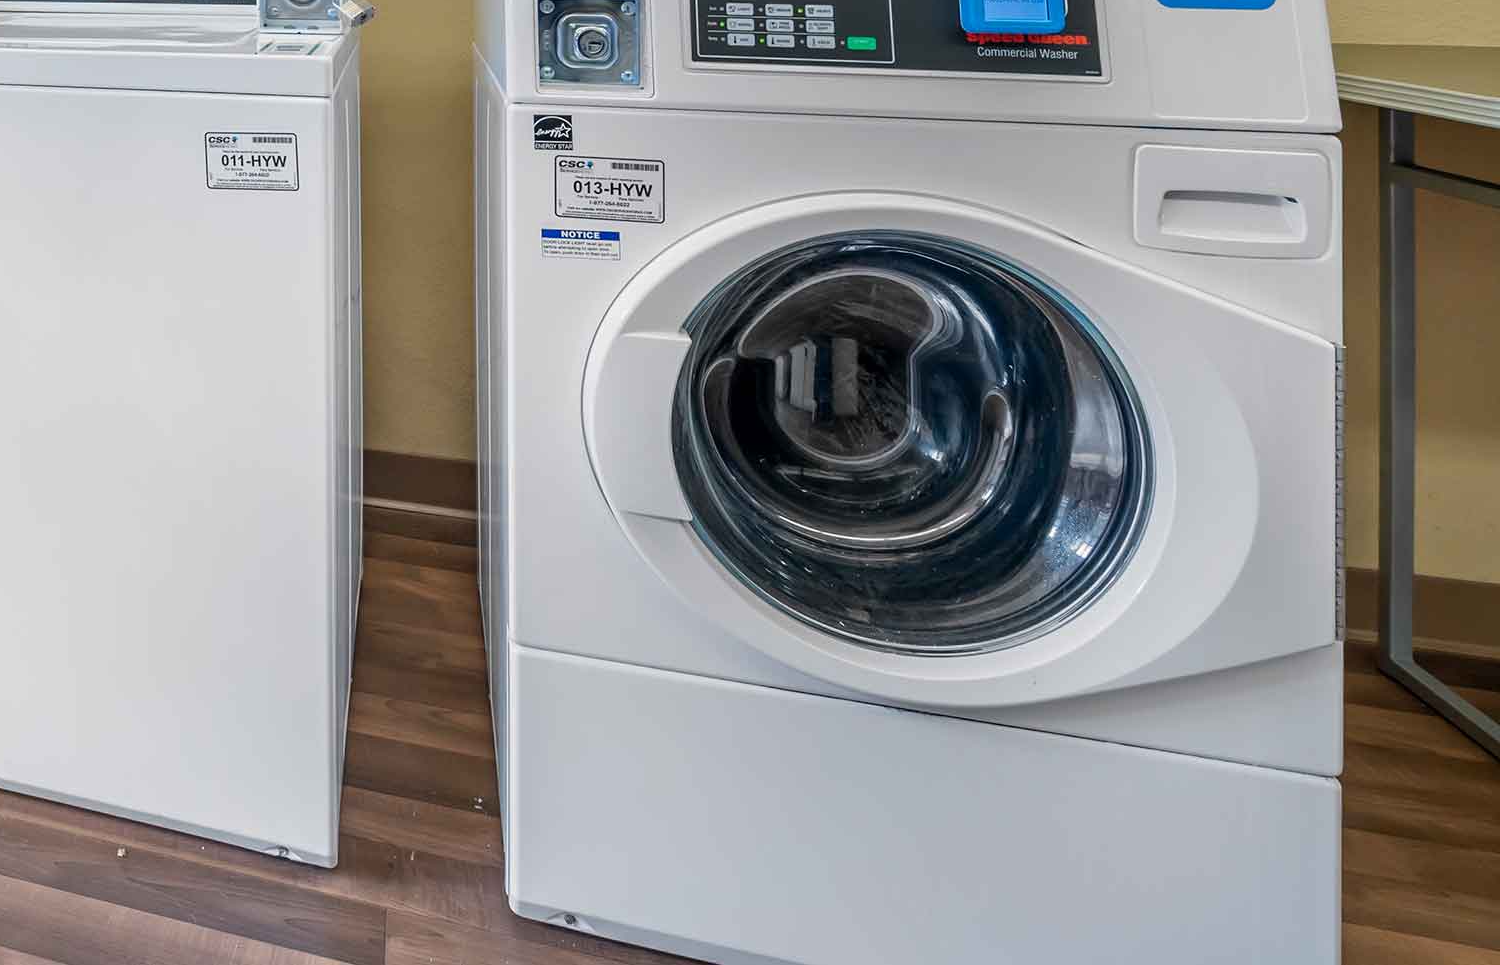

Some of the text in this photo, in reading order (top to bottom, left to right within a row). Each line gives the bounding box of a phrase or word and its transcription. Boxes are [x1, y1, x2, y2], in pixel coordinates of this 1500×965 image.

[976, 46, 1079, 60] Commercial Washer
[208, 136, 231, 144] CSC
[221, 154, 287, 168] 011-HYW
[558, 159, 586, 169] CSC
[573, 180, 653, 198] 013-HYW
[560, 230, 601, 239] NOTICE
